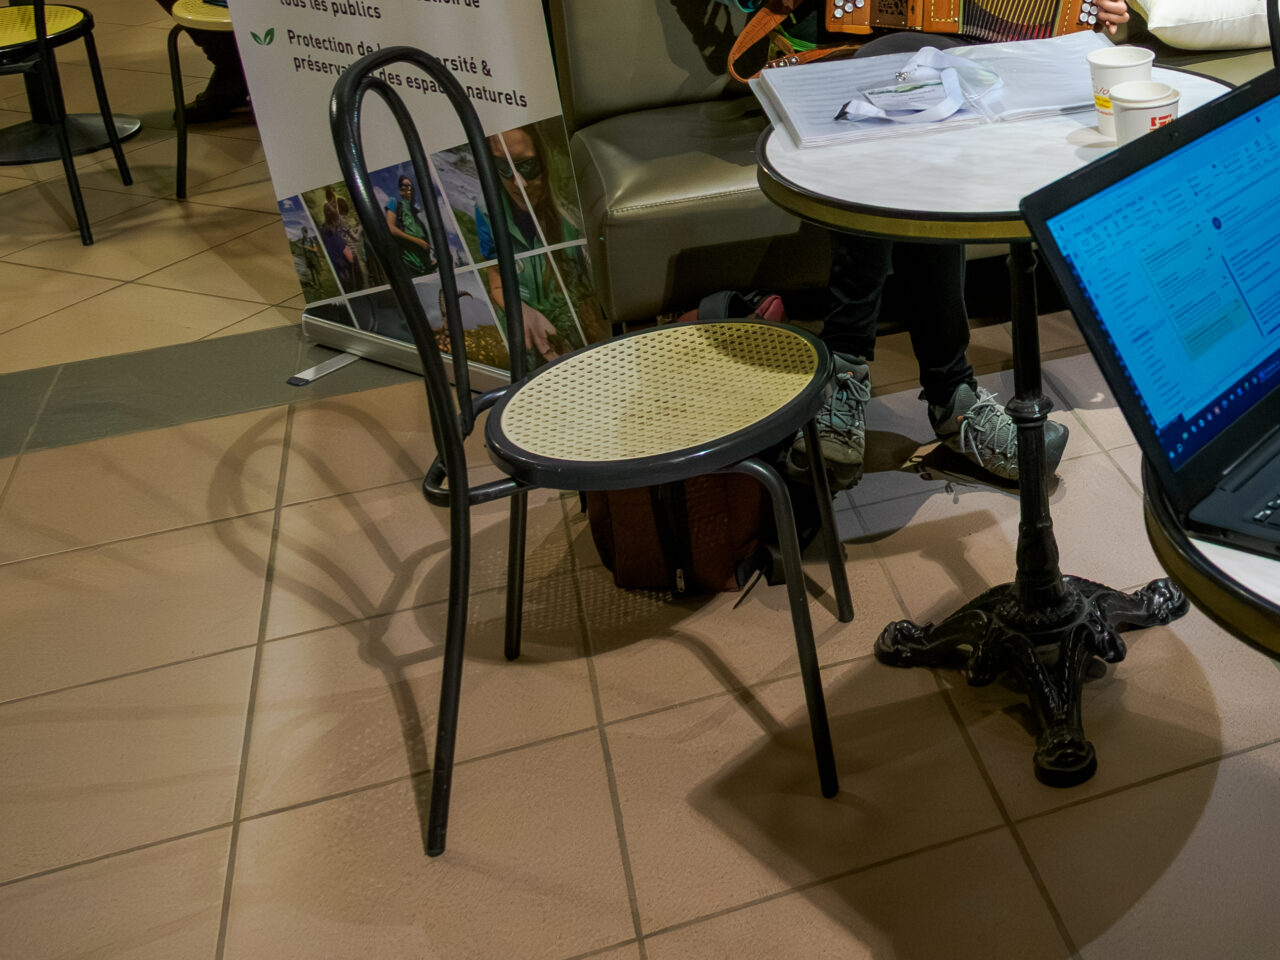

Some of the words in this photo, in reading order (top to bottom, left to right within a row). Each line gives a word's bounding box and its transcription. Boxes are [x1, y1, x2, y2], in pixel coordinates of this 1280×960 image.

[287, 29, 354, 55] Protection
[357, 40, 374, 57] de
[481, 60, 493, 78] &
[379, 68, 403, 86] des
[466, 85, 528, 108] naturels
